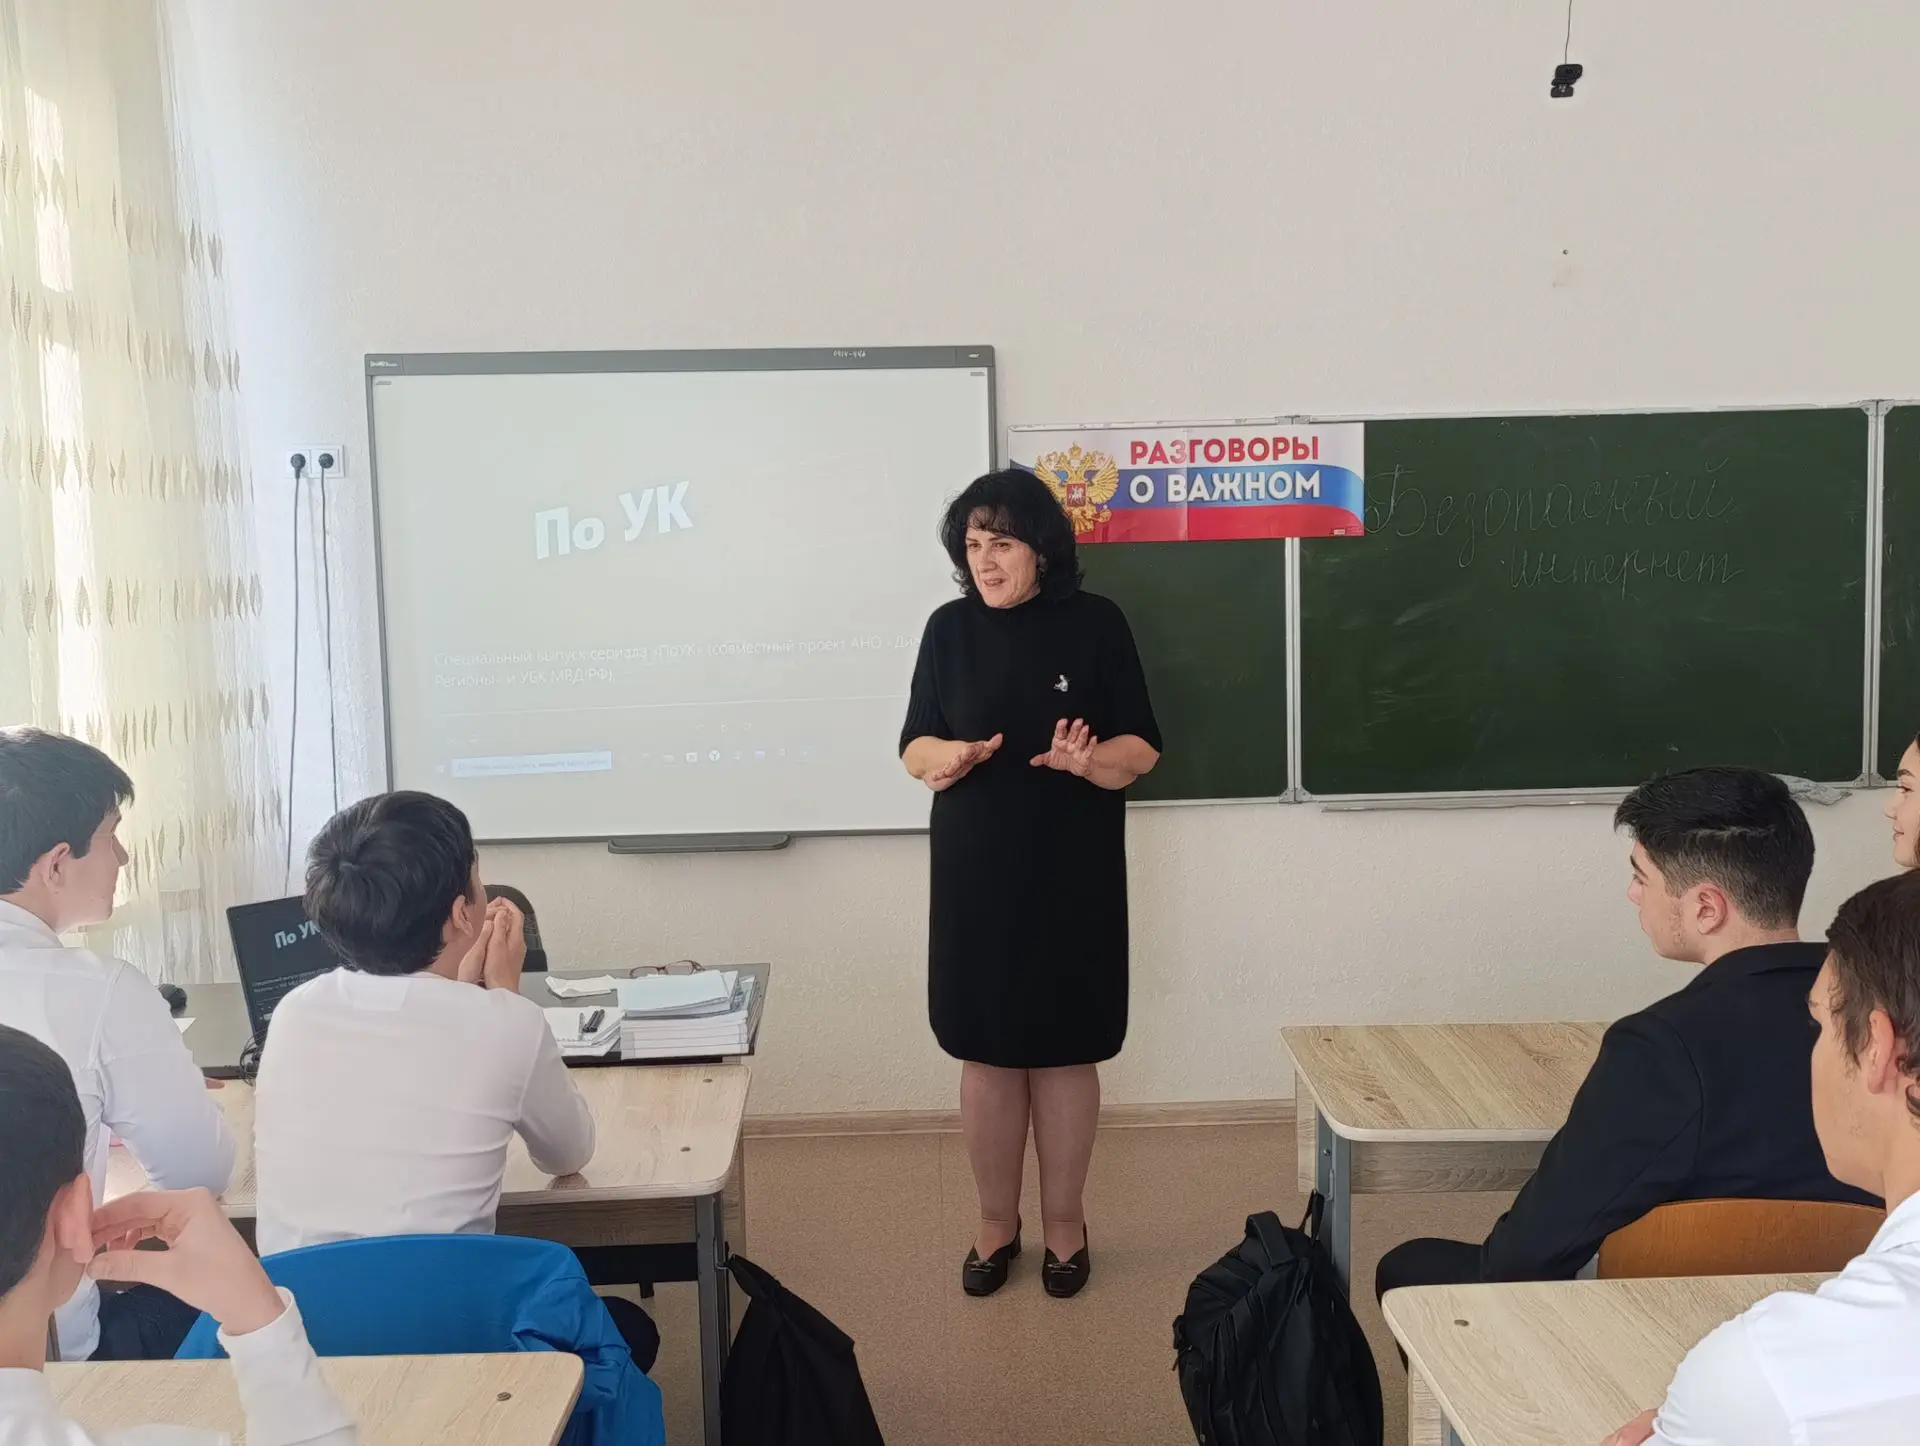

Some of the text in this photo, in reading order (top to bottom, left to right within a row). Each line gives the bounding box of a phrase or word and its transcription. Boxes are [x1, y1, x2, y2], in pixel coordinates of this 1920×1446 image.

[1130, 436, 1319, 465] РАЗГОВОРЫ
[1129, 470, 1321, 503] О ВАЖНОМ
[535, 480, 694, 560] По УК
[434, 648, 532, 669] Специальный
[536, 647, 586, 665] выпуск
[590, 646, 647, 664] сериала
[798, 638, 845, 659] проект
[852, 634, 882, 650] АНО
[507, 672, 516, 687] и
[551, 667, 584, 686] МВД
[274, 929, 297, 949] По
